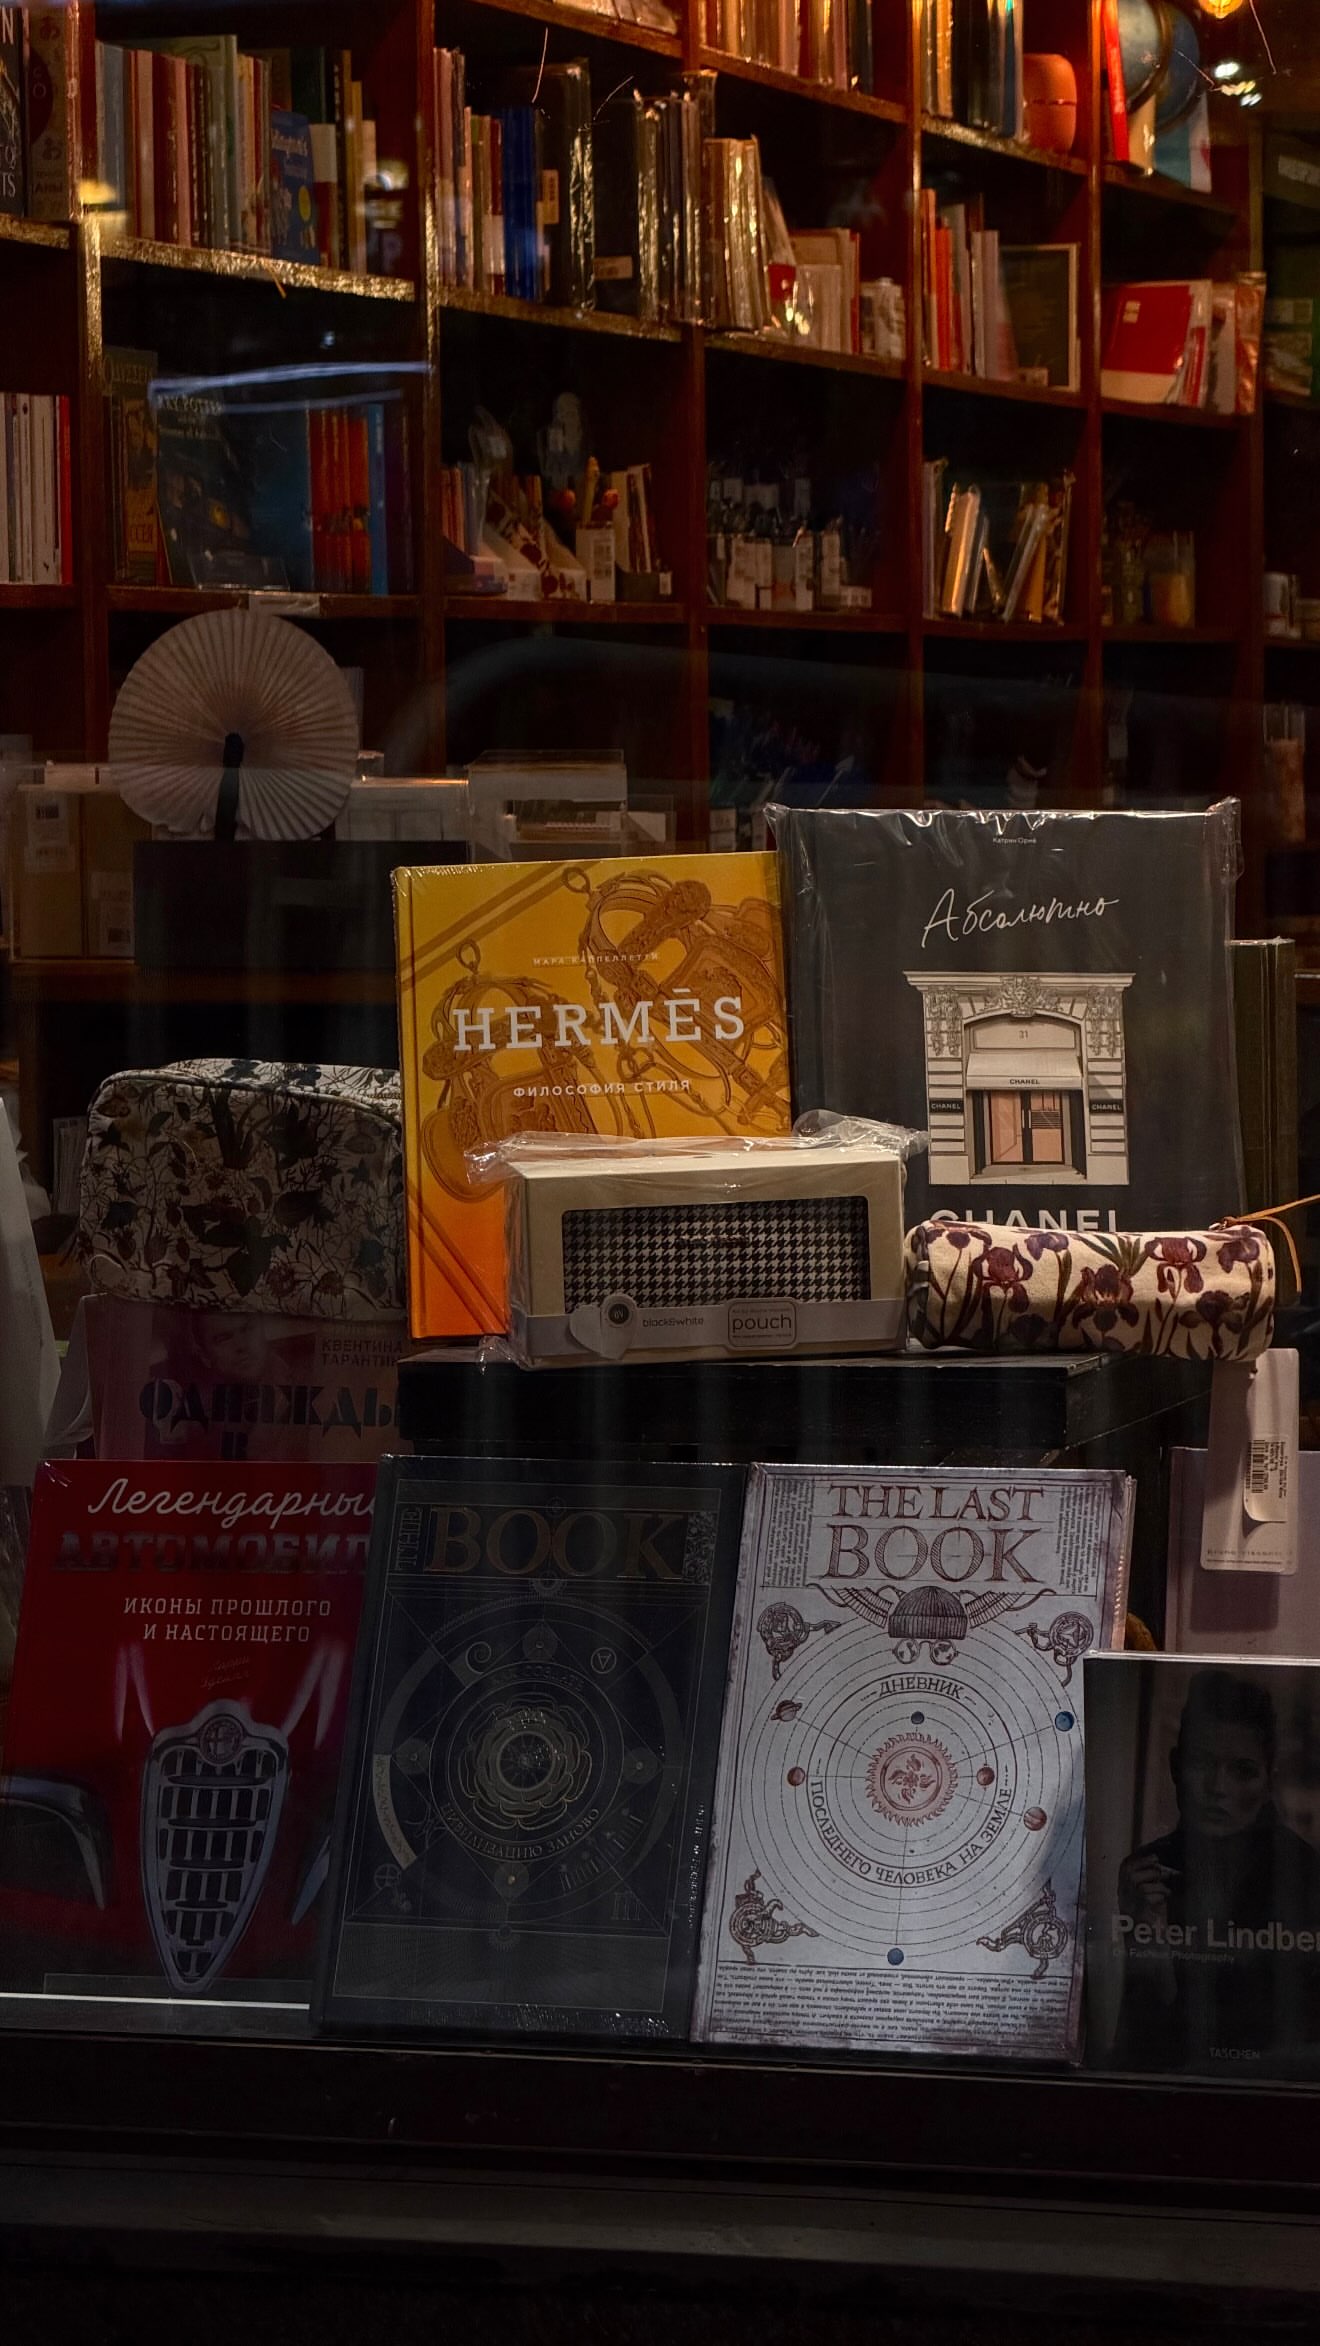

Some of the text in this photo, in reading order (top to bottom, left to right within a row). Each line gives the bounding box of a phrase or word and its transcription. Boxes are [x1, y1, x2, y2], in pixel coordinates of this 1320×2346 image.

[920, 887, 1120, 948] Абсолютно
[513, 1079, 692, 1098] ФИЛОСОФИЯ СТИЛЯ
[930, 1102, 961, 1110] CHANEL
[1091, 1103, 1122, 1111] CHANEL
[732, 1314, 792, 1334] pouch
[87, 1477, 375, 1530] Легендарны
[826, 1483, 1045, 1521] THE LAST
[423, 1503, 687, 1581] BOOK
[822, 1523, 1045, 1584] BOOK
[122, 1597, 332, 1618] ИКОНЫ ПРОШЛОГО
[143, 1623, 311, 1645] И НАСТОЯЩЕГО
[878, 1675, 966, 1700] ДНЕВНИК
[810, 1780, 1012, 1886] ПОСЛЕДНЕГО ЧЕЛОВЕКА НА ЗЕМЛЕ
[1111, 1913, 1198, 1947] Peter
